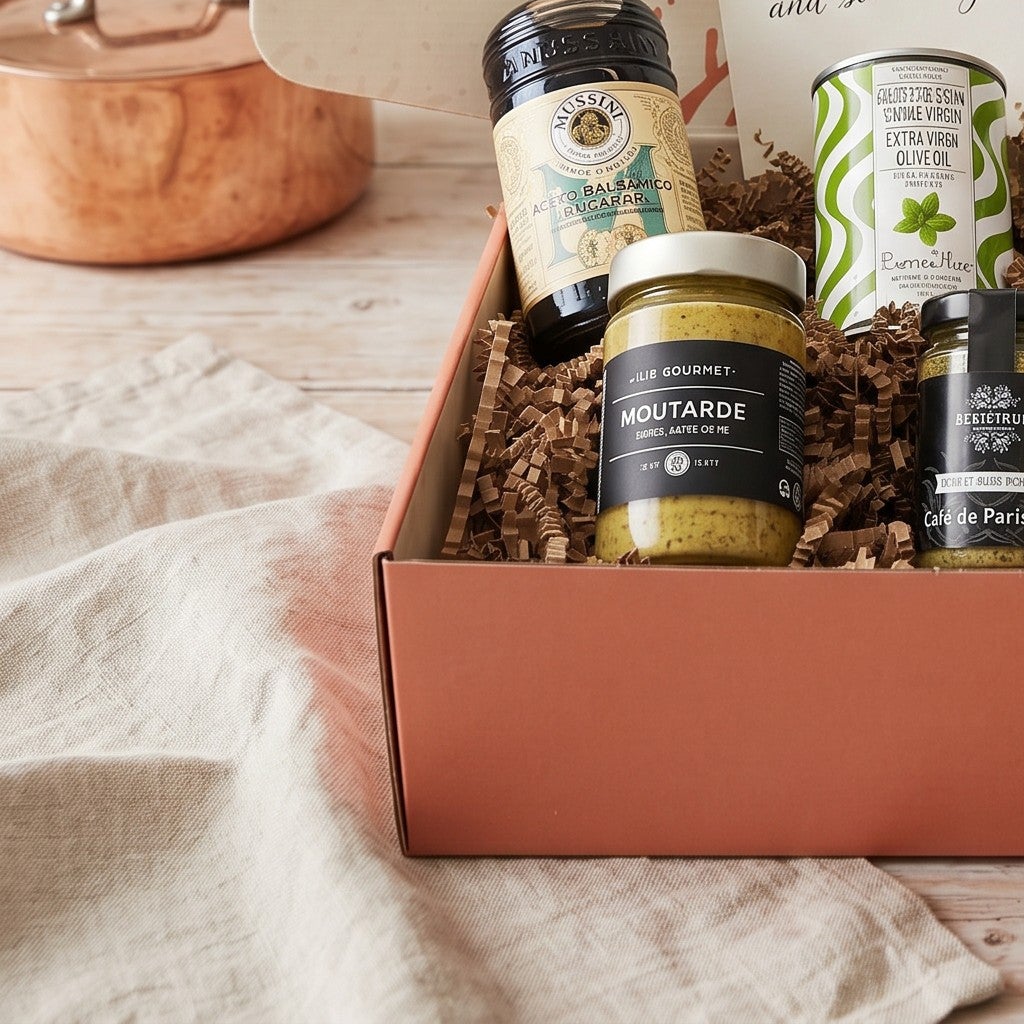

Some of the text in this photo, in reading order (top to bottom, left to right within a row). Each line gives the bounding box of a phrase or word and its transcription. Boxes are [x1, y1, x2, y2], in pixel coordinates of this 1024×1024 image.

[554, 93, 625, 131] MUSSINI
[886, 130, 925, 148] EXTRA
[896, 150, 952, 168] OLIVE OIL
[583, 179, 673, 198] BALSAMICO
[620, 400, 746, 428] MOUTARDE
[924, 507, 952, 528] Café
[957, 507, 978, 525] de
